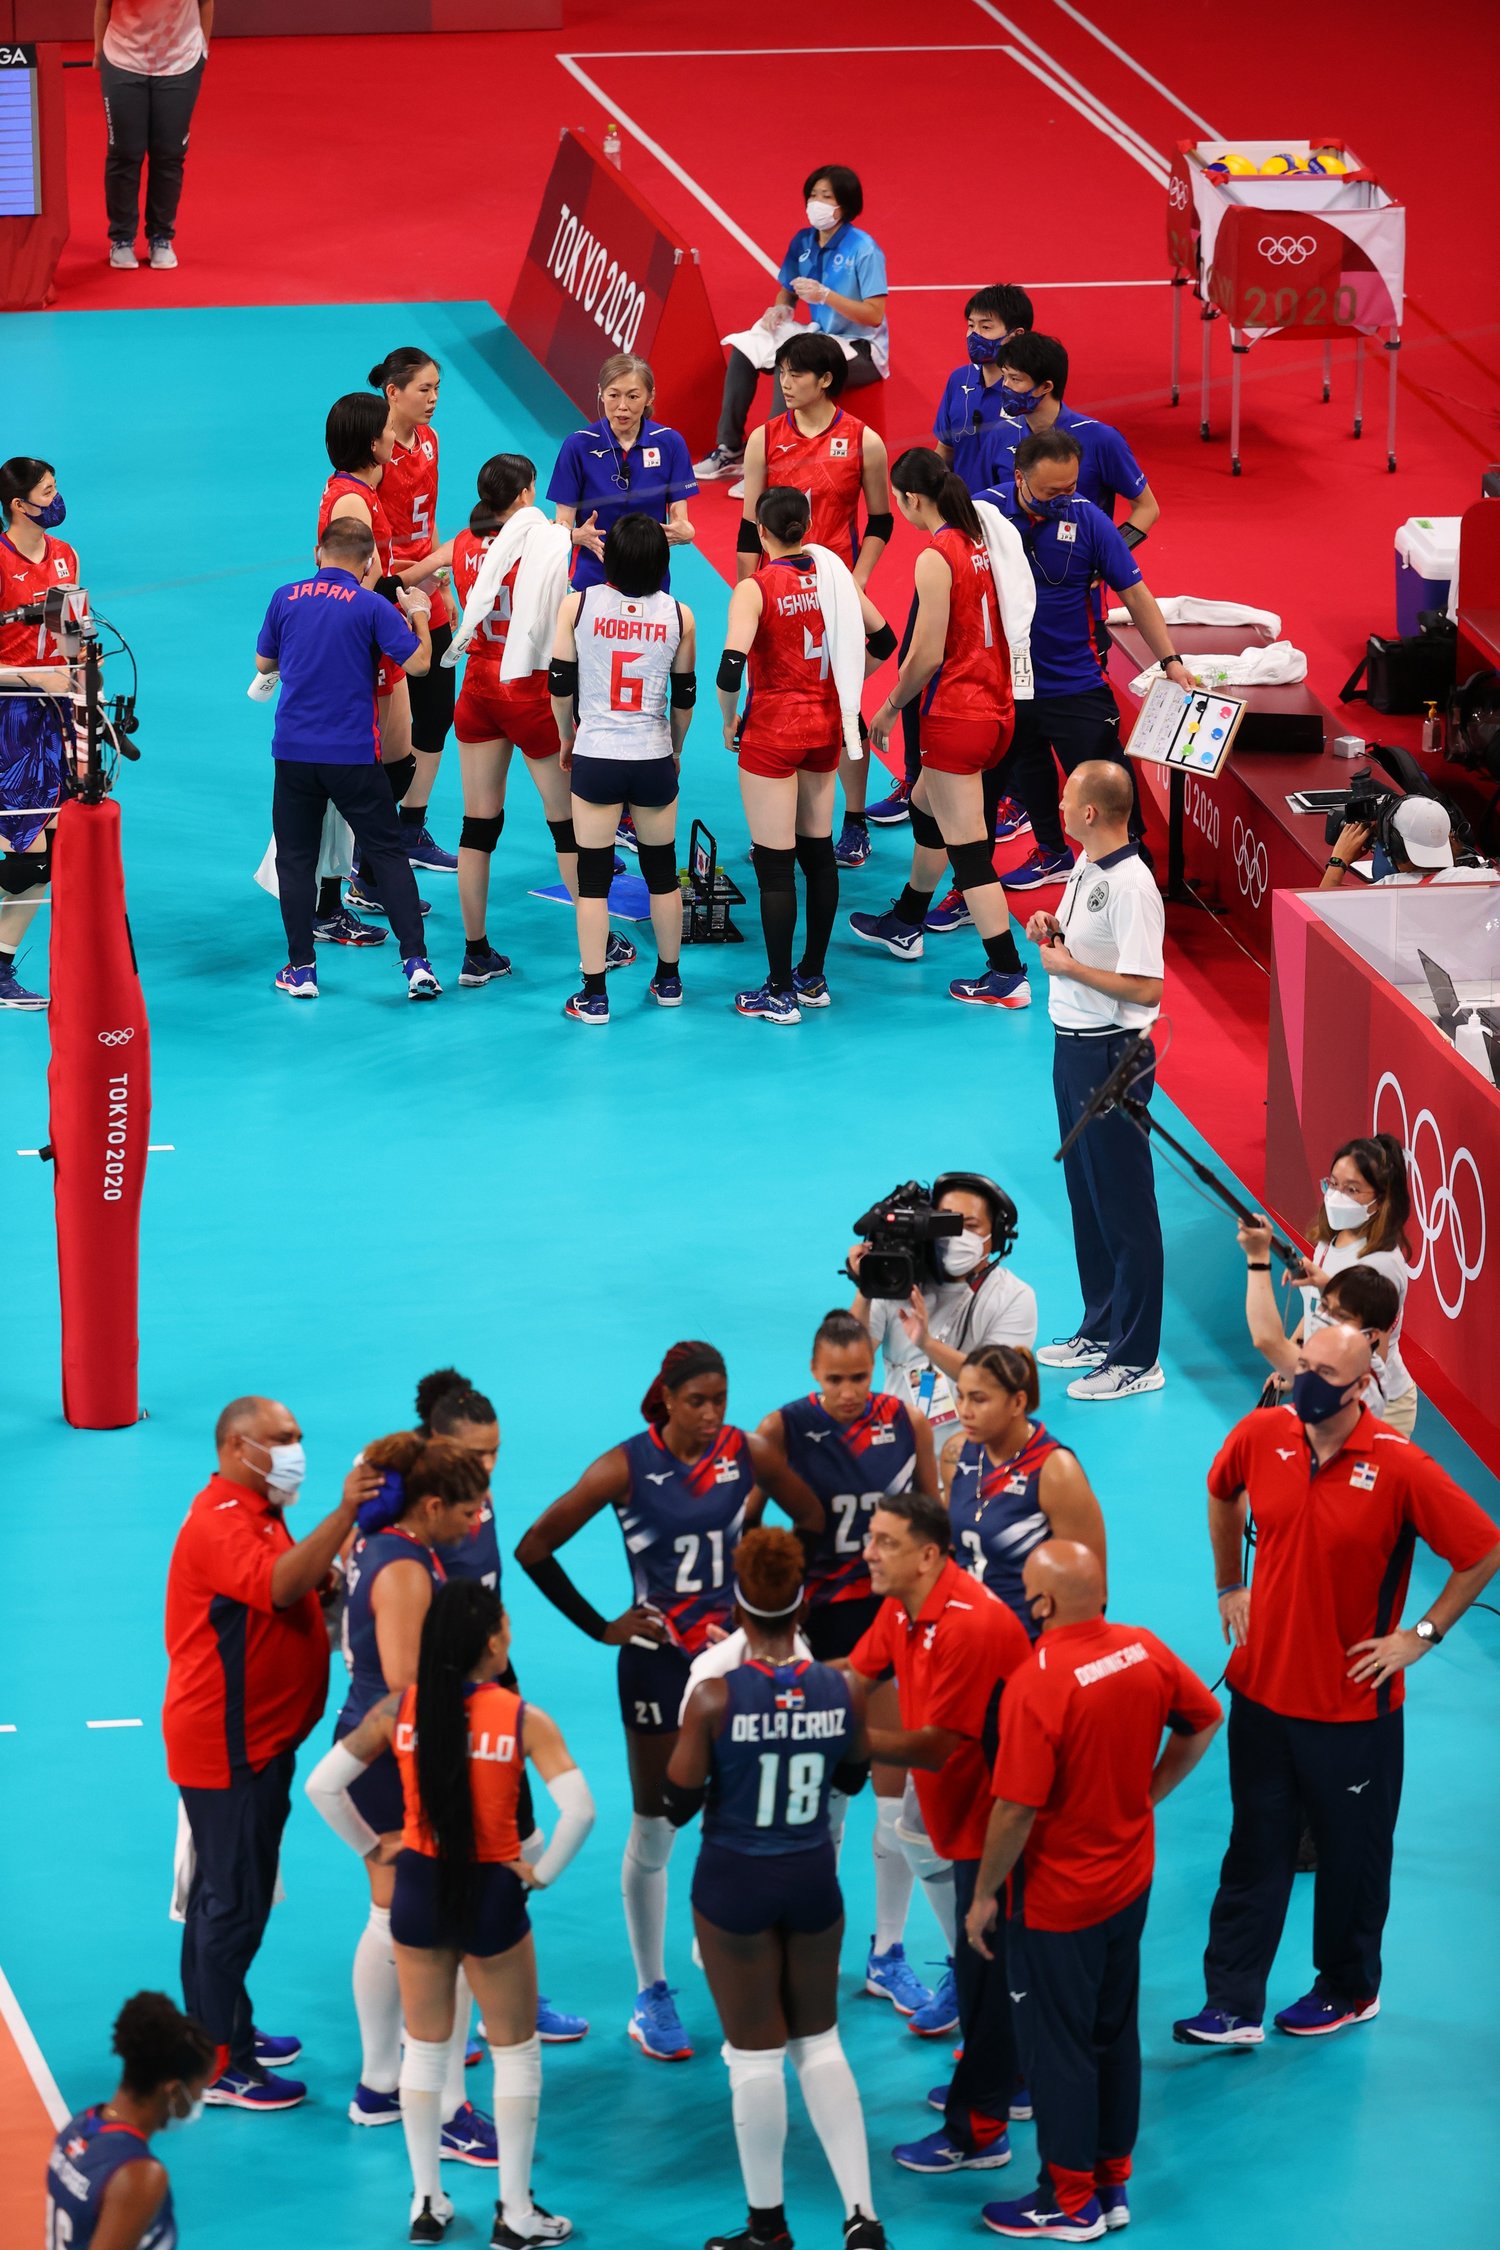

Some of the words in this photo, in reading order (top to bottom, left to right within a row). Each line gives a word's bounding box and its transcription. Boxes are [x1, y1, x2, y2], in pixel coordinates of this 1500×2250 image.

[547, 203, 608, 312] TOKYO
[594, 261, 645, 354] 2020
[1244, 285, 1357, 327] 2020
[411, 494, 429, 540] 5
[288, 582, 357, 603] JAPAN
[981, 591, 993, 648] 1
[594, 617, 667, 644] KOBATA
[803, 625, 830, 680] 4
[610, 650, 645, 712] 6
[1193, 783, 1220, 849] 2020
[107, 1073, 128, 1145] TOKYO
[103, 1149, 125, 1201] 2020
[673, 1530, 724, 1593] 21
[634, 1701, 663, 1725] 21
[731, 1714, 760, 1742] DE
[762, 1711, 788, 1740] LA
[791, 1708, 846, 1740] CRUZ
[755, 1752, 825, 1827] 18
